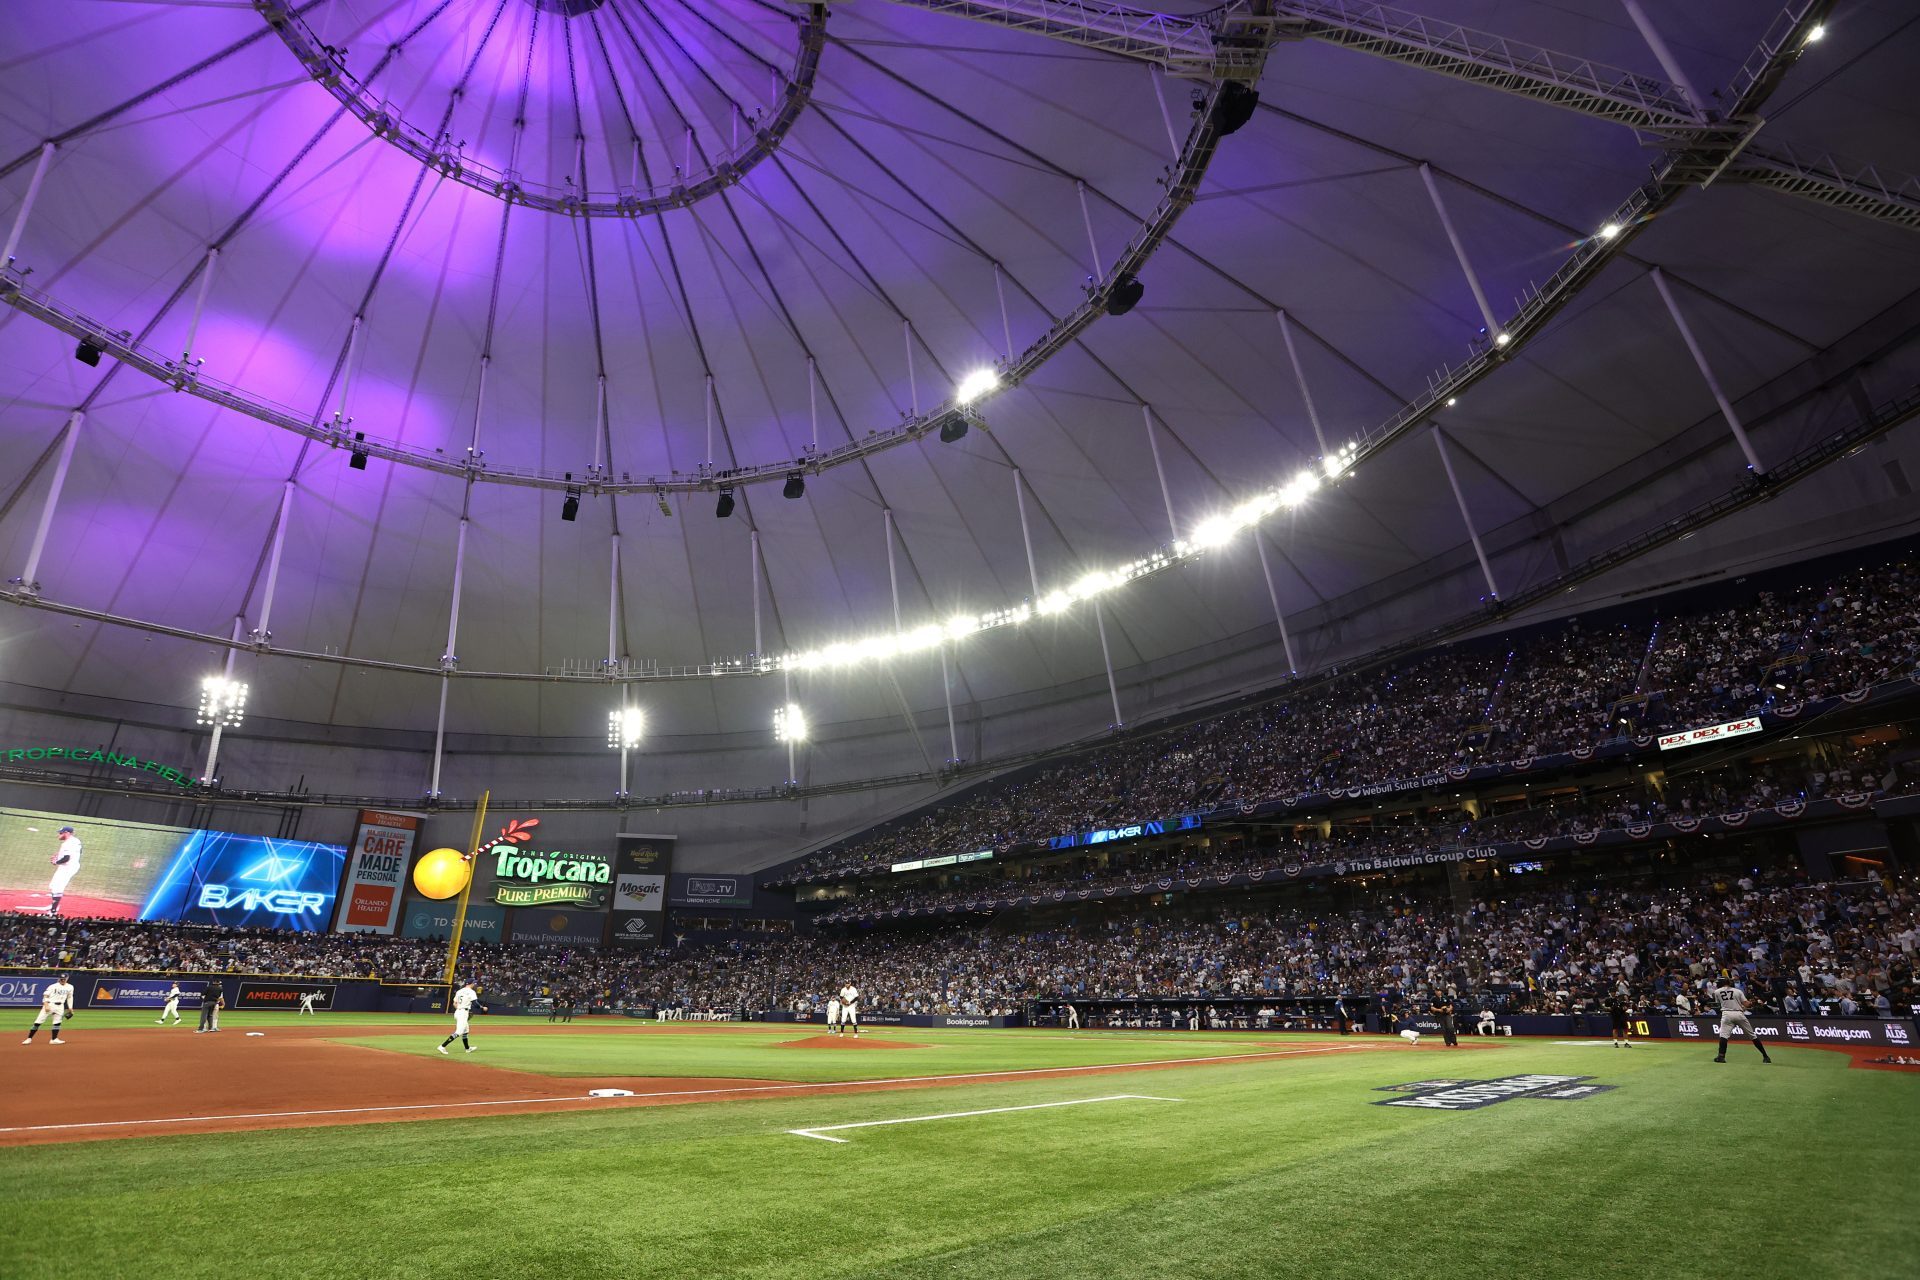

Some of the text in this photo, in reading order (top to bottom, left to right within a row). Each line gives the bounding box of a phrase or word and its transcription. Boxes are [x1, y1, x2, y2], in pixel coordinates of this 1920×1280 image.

[1727, 720, 1756, 732] DEX
[1692, 727, 1720, 739] DEX
[1660, 734, 1687, 746] DEX
[1362, 774, 1448, 797] Webull Suite Level
[1108, 825, 1142, 840] BAKER
[363, 836, 406, 857] CARE
[359, 854, 403, 873] MADE
[563, 853, 607, 862] ORIGINAL
[1350, 846, 1497, 872] The Baldwin Group Club
[491, 845, 611, 884] Tropicana
[356, 870, 398, 883] PERSONAL
[619, 882, 661, 893] Mosaic
[198, 883, 326, 916] BAKER
[497, 887, 593, 902] PURE PREMIUM
[354, 898, 389, 907] ORLANDO
[357, 905, 385, 913] HEALTH
[433, 917, 496, 929] TD SNNEX
[512, 932, 600, 944] DREAM FINDERS HOMES
[246, 992, 299, 1001] AMERANT
[1719, 990, 1735, 1001] 27
[946, 1018, 990, 1027] Booking.com
[1678, 1025, 1699, 1033] ALDS
[1786, 1026, 1809, 1036] ALDS
[1813, 1026, 1872, 1041] Booking.com
[1885, 1029, 1908, 1039] ALDS
